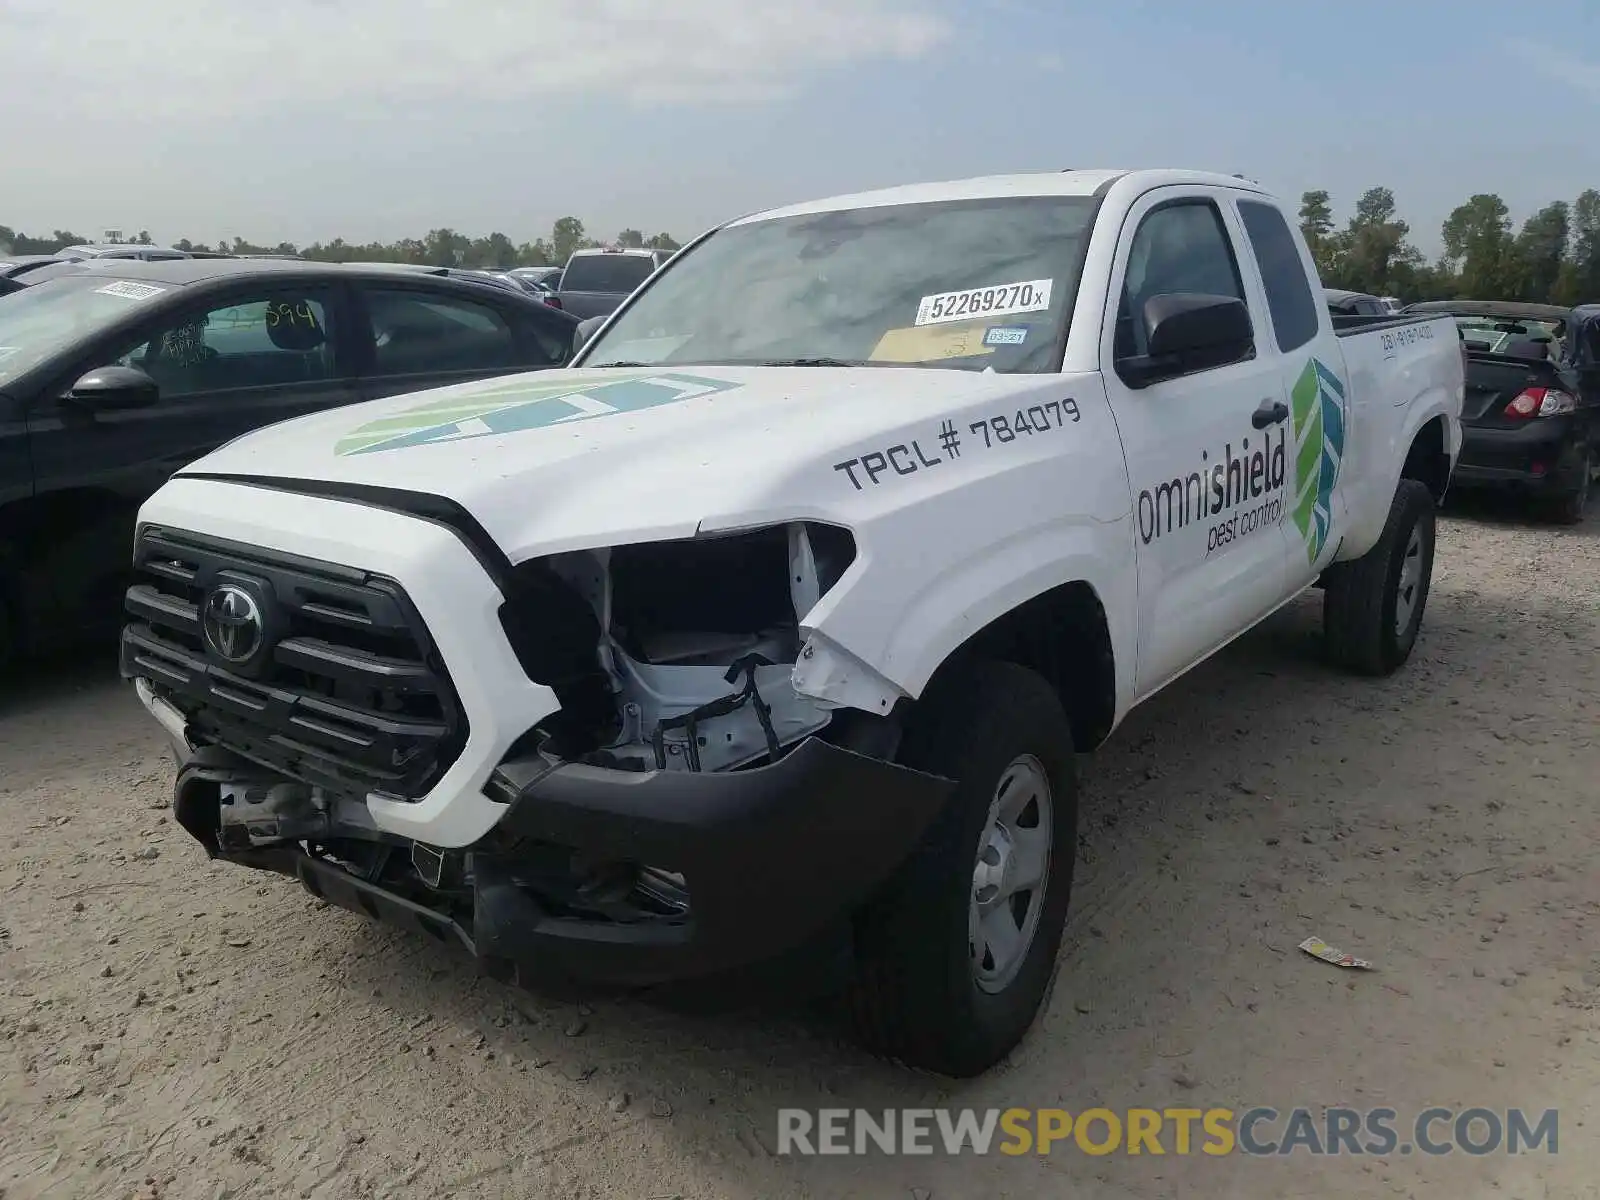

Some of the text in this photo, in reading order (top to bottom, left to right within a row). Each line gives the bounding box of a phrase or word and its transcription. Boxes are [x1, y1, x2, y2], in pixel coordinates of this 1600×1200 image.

[833, 397, 1082, 491] TPCL # 784079
[1137, 427, 1286, 546] omnishield
[1204, 493, 1286, 562] pest control
